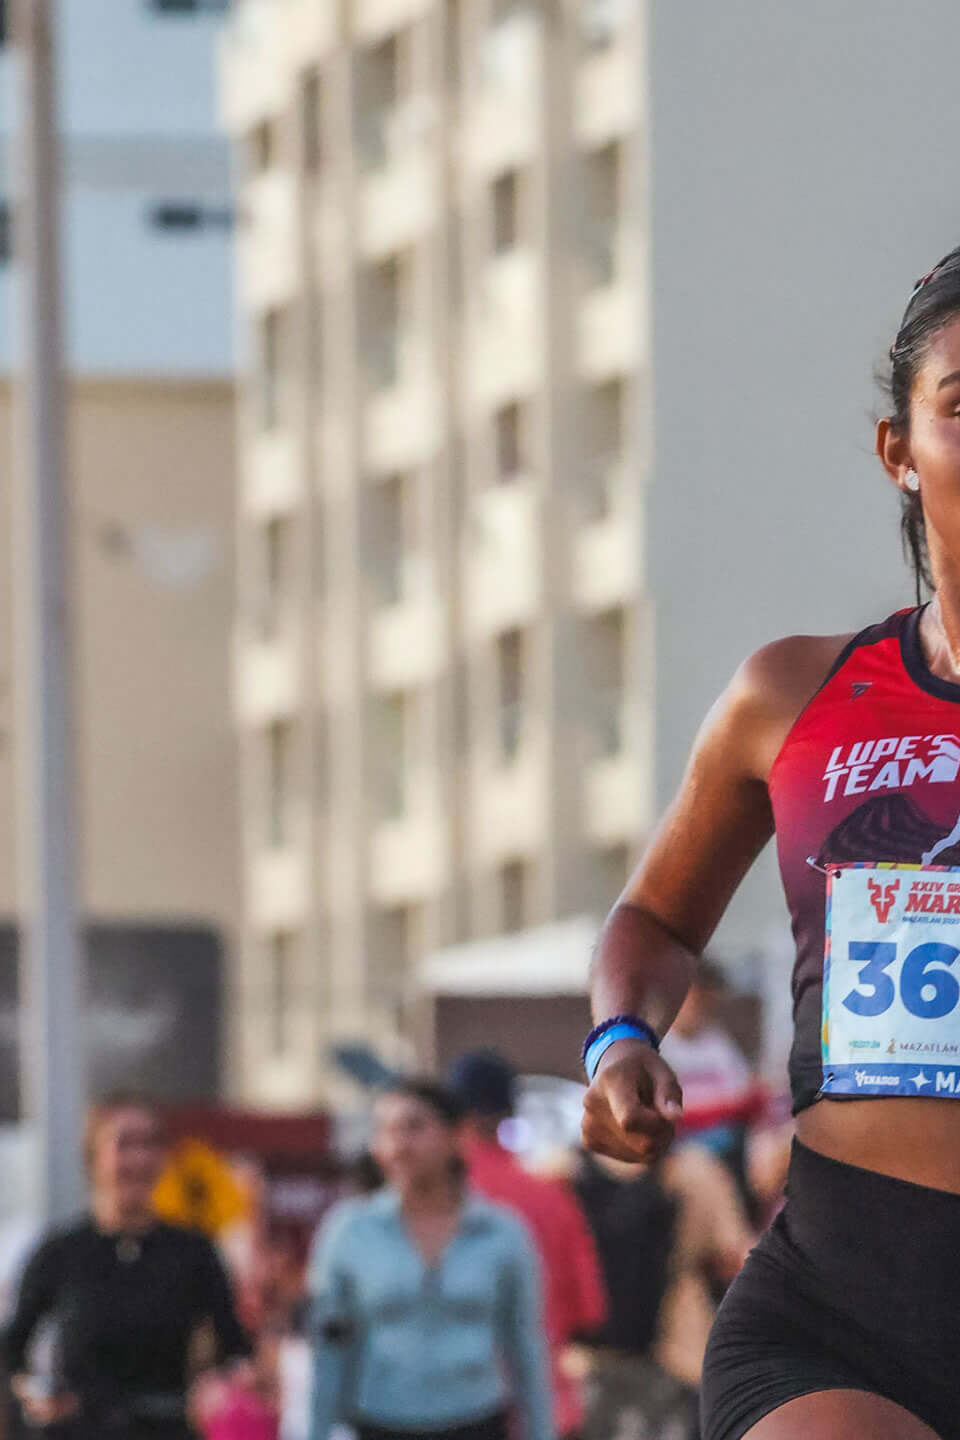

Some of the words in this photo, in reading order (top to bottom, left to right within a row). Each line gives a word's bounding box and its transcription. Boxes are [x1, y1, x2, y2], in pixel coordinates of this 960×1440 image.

[825, 735, 954, 772] LUPE'S
[822, 756, 957, 802] TEAM
[910, 881, 944, 892] XXIV
